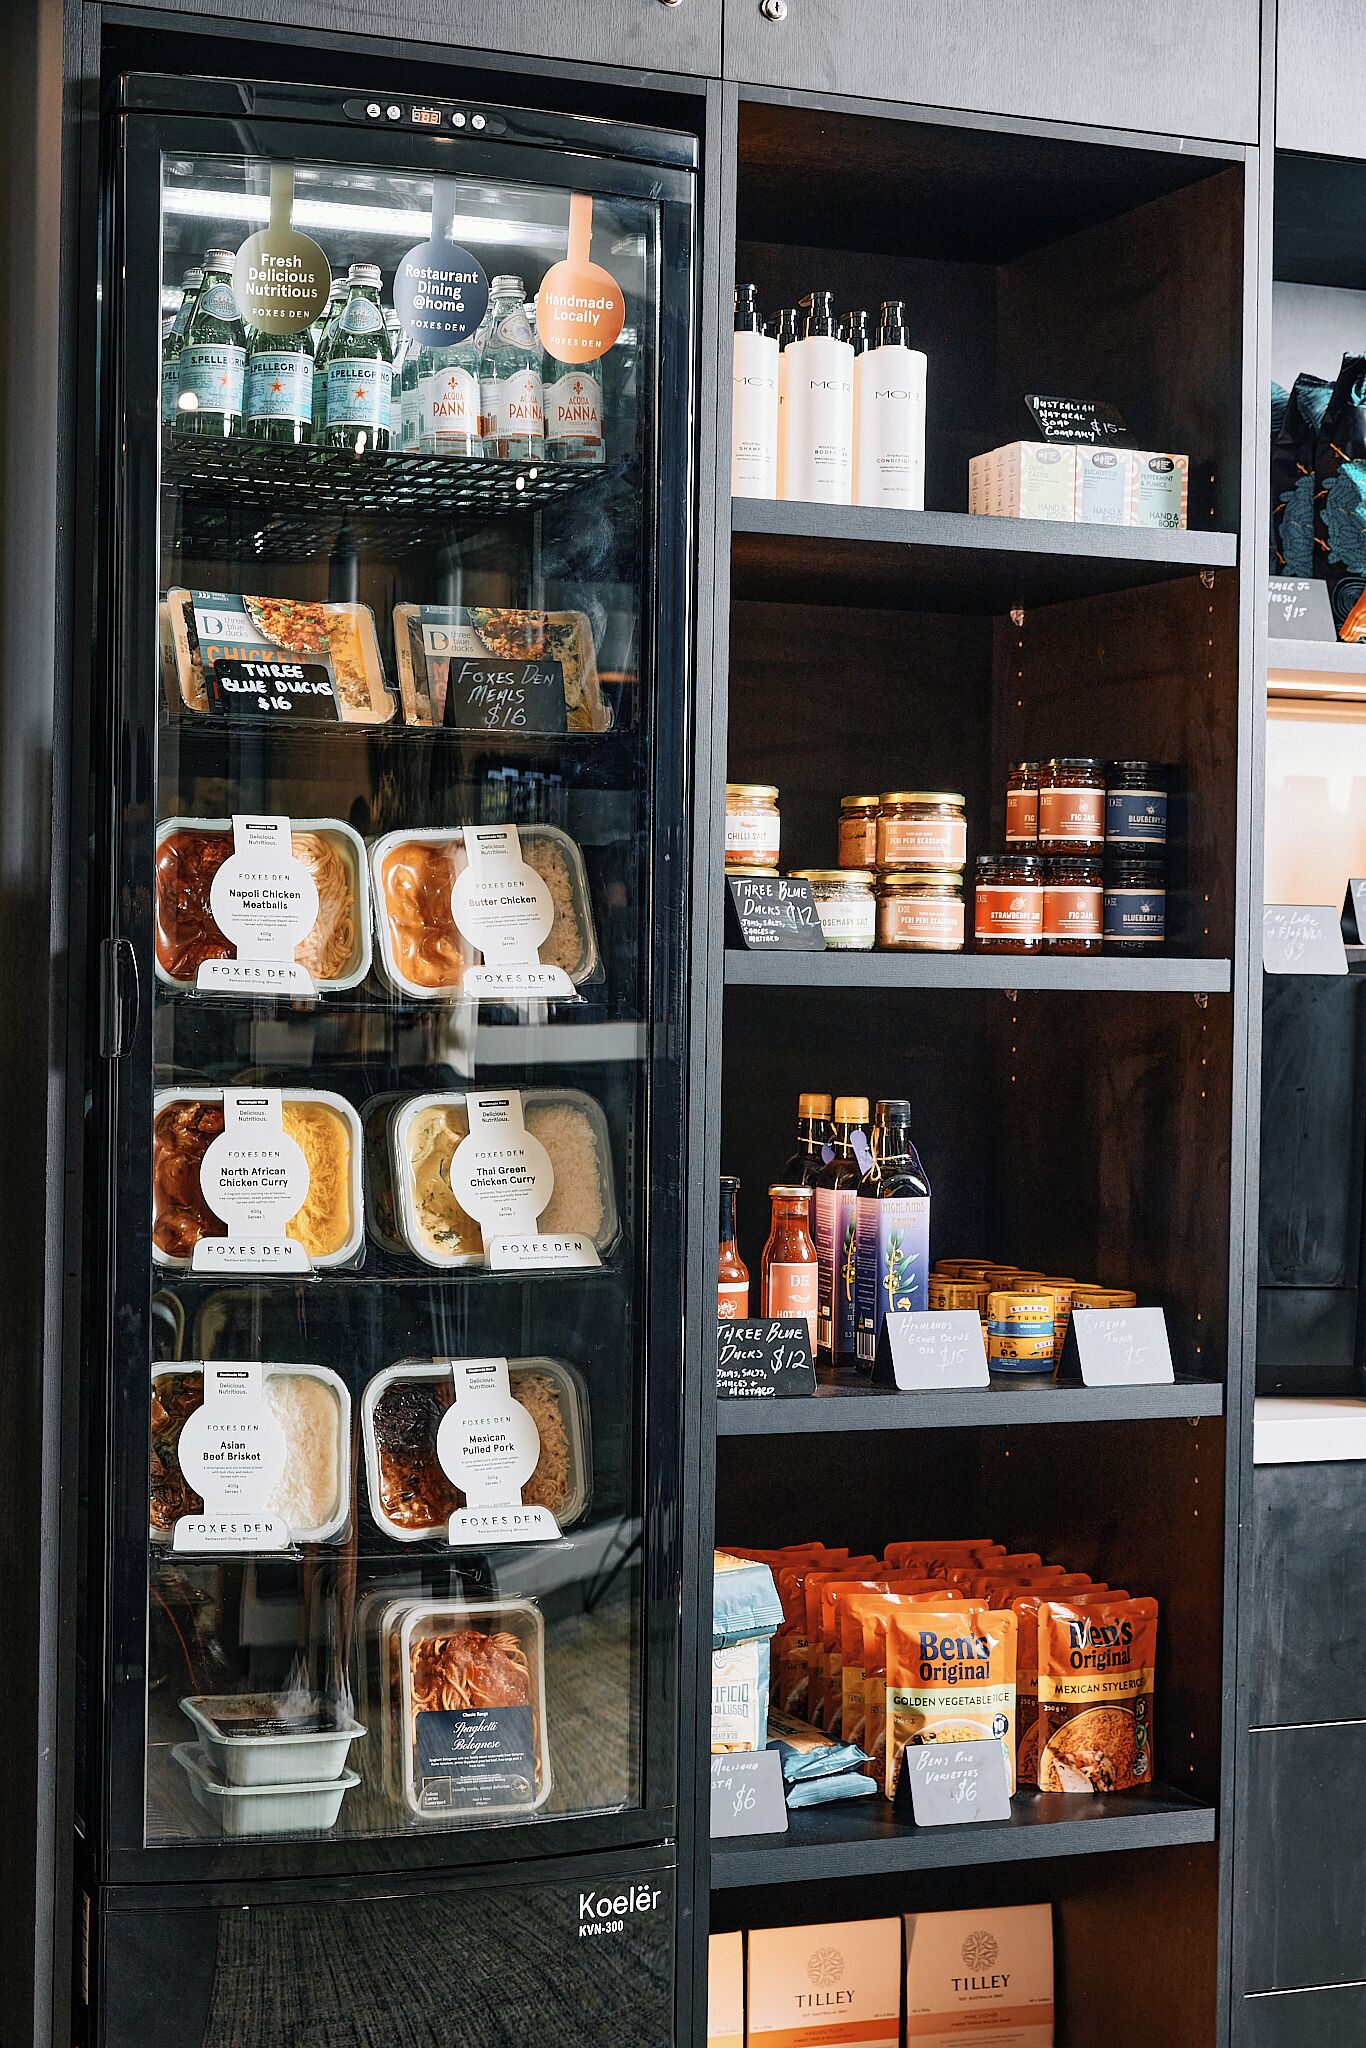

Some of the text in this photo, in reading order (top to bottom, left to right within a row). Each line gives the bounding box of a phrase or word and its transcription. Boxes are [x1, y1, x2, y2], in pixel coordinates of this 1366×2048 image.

[261, 253, 301, 268] Fresh
[249, 268, 315, 282] Delicious
[405, 264, 478, 284] Restaurant
[245, 282, 318, 298] Nutritious
[418, 281, 462, 299] Dining
[413, 296, 465, 313] @home
[545, 292, 614, 309] Handmade
[252, 308, 310, 318] FOXES DEN
[554, 308, 600, 326] Locally
[410, 320, 466, 332] FOXES DEN
[550, 336, 601, 348] FOXES DEN
[330, 370, 390, 382] S.PELLEGRNO
[509, 404, 543, 420] PANNA
[558, 406, 598, 421] PANNA
[1045, 426, 1095, 442] COMPANY
[1141, 474, 1173, 482] PEPPERMINT
[1159, 520, 1179, 528] BODY
[1284, 604, 1307, 621] $15
[225, 617, 246, 625] three
[225, 629, 248, 638] ducks
[451, 645, 474, 653] ducks
[241, 664, 304, 679] THREE
[458, 661, 554, 686] FOXES DEN
[221, 678, 334, 696] BLUE DUCKS
[258, 696, 292, 711] $16
[467, 688, 526, 705] MEALS
[485, 704, 527, 728] $16
[1129, 815, 1160, 823] BLUEBERRY
[230, 889, 300, 899] Napoli Chicken
[732, 880, 807, 900] THREE BLUE
[243, 901, 288, 909] Meatballs
[468, 896, 537, 907] Butter Chicken
[743, 900, 822, 933] DUCKS $12
[991, 911, 1026, 919] STRAWBERRY
[212, 967, 296, 978] FOXES DEN
[476, 974, 556, 983] FOXES DEN
[221, 1167, 286, 1176] North African
[477, 1165, 527, 1176] Thai Green
[219, 1178, 288, 1188] Chicken Curry
[470, 1176, 536, 1187] Chicken Curry
[207, 1246, 292, 1255] FOXES DEN
[502, 1242, 582, 1253] FOXES DEN
[777, 1310, 817, 1318] HOT SAUCE
[717, 1323, 803, 1344] THREE BLUE
[719, 1345, 810, 1374] DUCKS $12
[220, 1441, 246, 1450] Asian
[469, 1434, 506, 1444] Mexican
[203, 1452, 261, 1461] Beef Brisket
[463, 1443, 515, 1455] Pulled Pork
[188, 1524, 273, 1533] FOXES DEN
[461, 1515, 542, 1527] FOXES DEN
[1069, 1617, 1133, 1649] Ben's
[918, 1631, 991, 1661] Ben's
[1069, 1648, 1131, 1671] Original
[919, 1661, 991, 1684] Original
[712, 1684, 749, 1702] TIFICIO
[1055, 1677, 1144, 1695] MEXICAN STYLE RICE
[893, 1696, 936, 1706] GOLDEN
[937, 1695, 992, 1706] VEGETABLE
[722, 1703, 748, 1718] LUSSO
[453, 1719, 498, 1738] Spaghetti
[452, 1737, 500, 1755] Bolognese
[712, 1778, 732, 1790] STA
[955, 1778, 977, 1804] $6
[733, 1783, 756, 1817] $6
[580, 1885, 661, 1919] Koelër
[579, 1920, 624, 1937] KVN-300
[952, 1974, 1010, 1991] TILLEY
[795, 1990, 855, 2008] TILLEY
